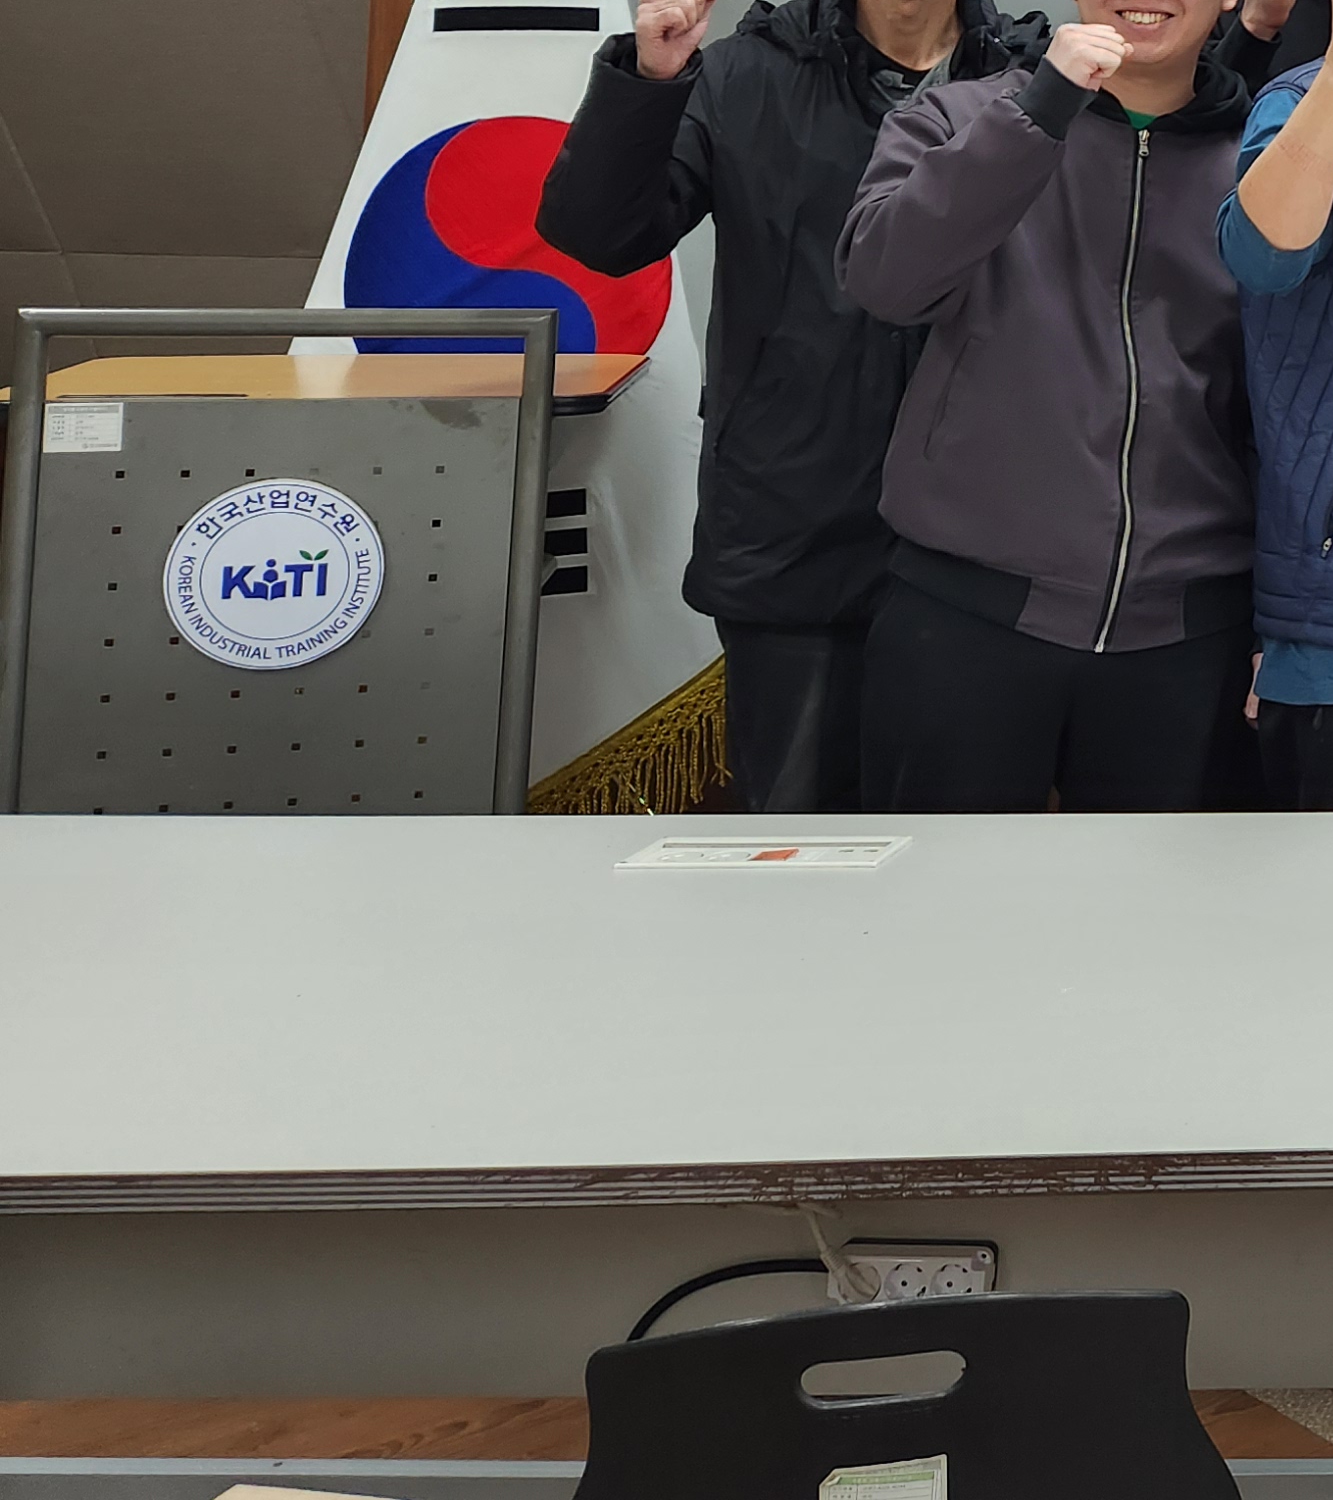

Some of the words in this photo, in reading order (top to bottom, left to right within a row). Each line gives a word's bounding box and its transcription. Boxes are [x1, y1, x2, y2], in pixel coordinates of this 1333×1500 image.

[195, 489, 361, 540] 한국산업연수원
[177, 554, 198, 616] KOREAN
[188, 613, 272, 660] INDUSTRIAL
[275, 617, 349, 659] TRAINING
[341, 547, 372, 619] INSTITUTE
